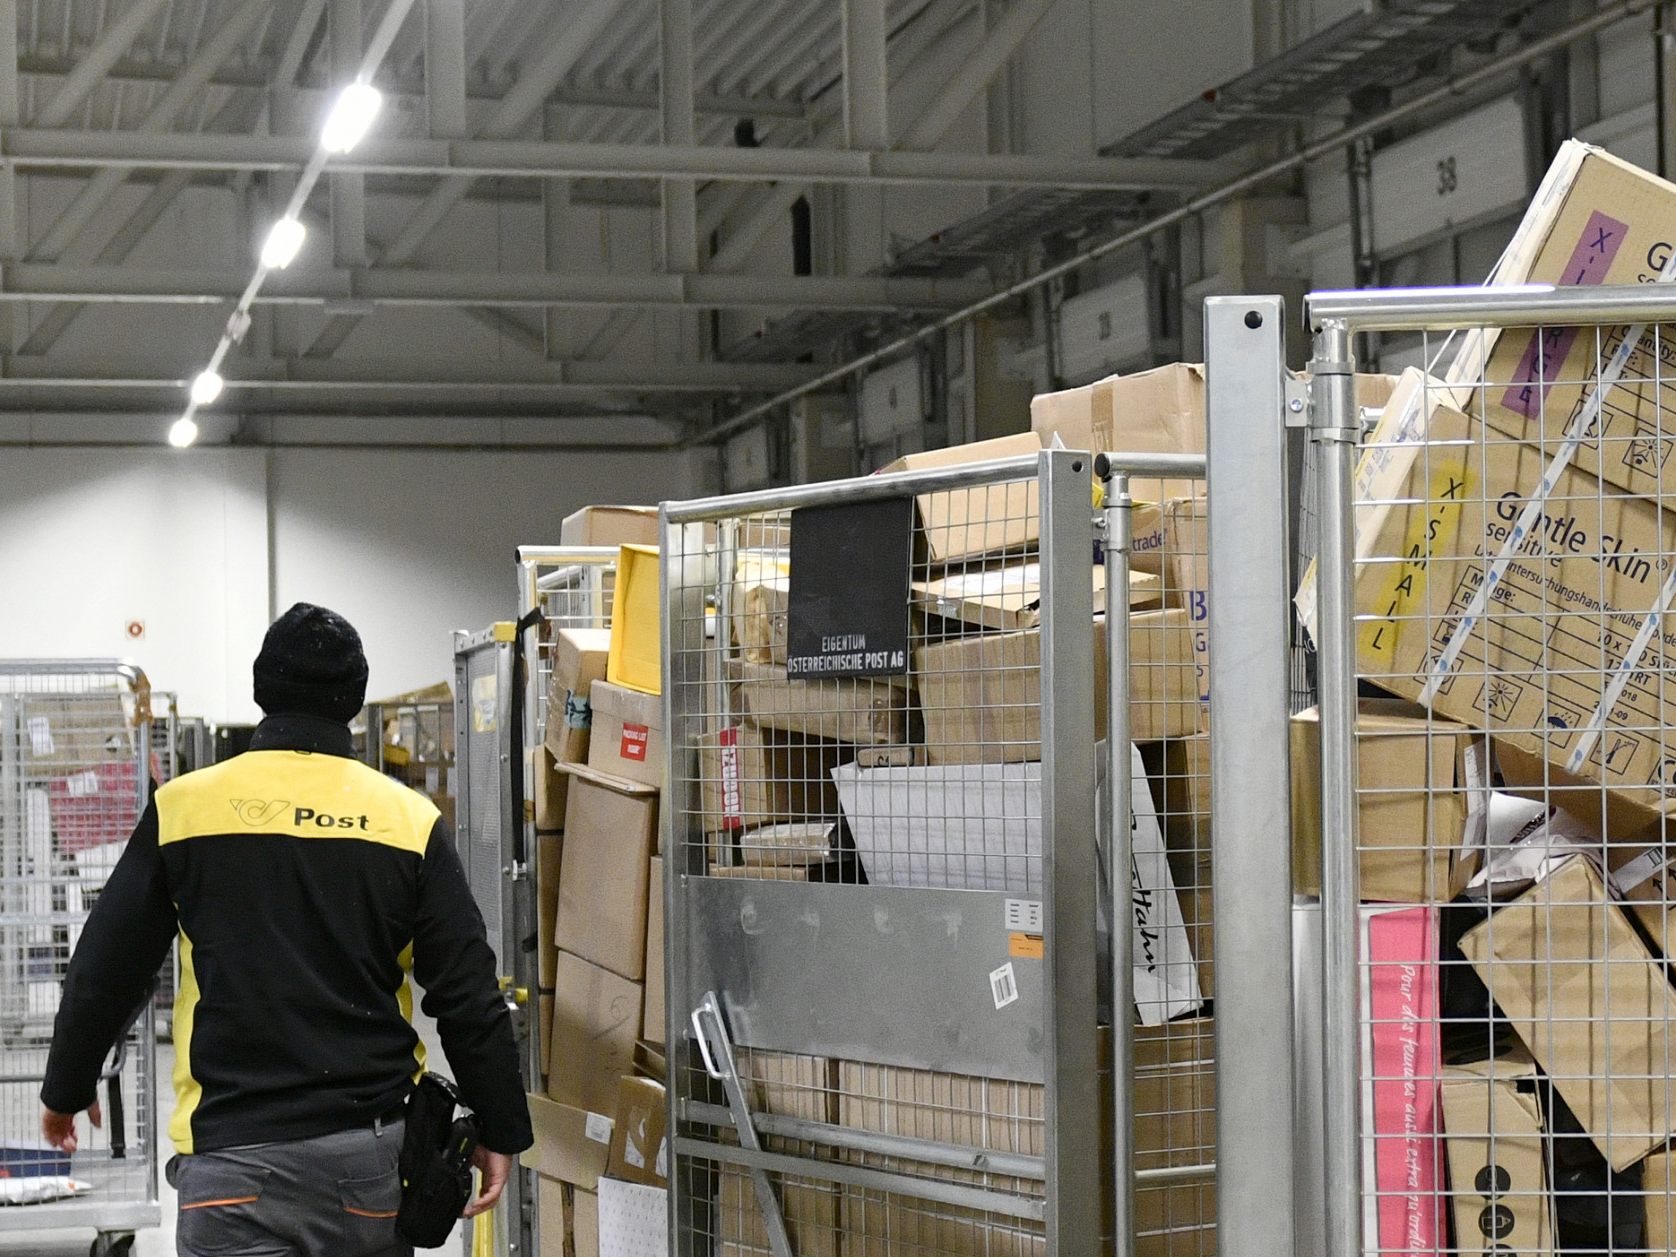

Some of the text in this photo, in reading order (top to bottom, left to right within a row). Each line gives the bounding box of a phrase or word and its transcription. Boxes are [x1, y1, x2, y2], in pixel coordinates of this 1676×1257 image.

[1496, 491, 1588, 554] Gntle
[1371, 477, 1463, 651] X-SMALL
[1486, 521, 1563, 570] sesitive
[1471, 572, 1515, 602] Mnge:
[822, 634, 866, 652] EIGENTUM
[865, 651, 888, 669] POST
[891, 650, 904, 668] AG
[293, 806, 370, 832] Post
[1400, 965, 1416, 1002] Pour
[1403, 1103, 1419, 1146] aussi
[1405, 1150, 1419, 1189] extra
